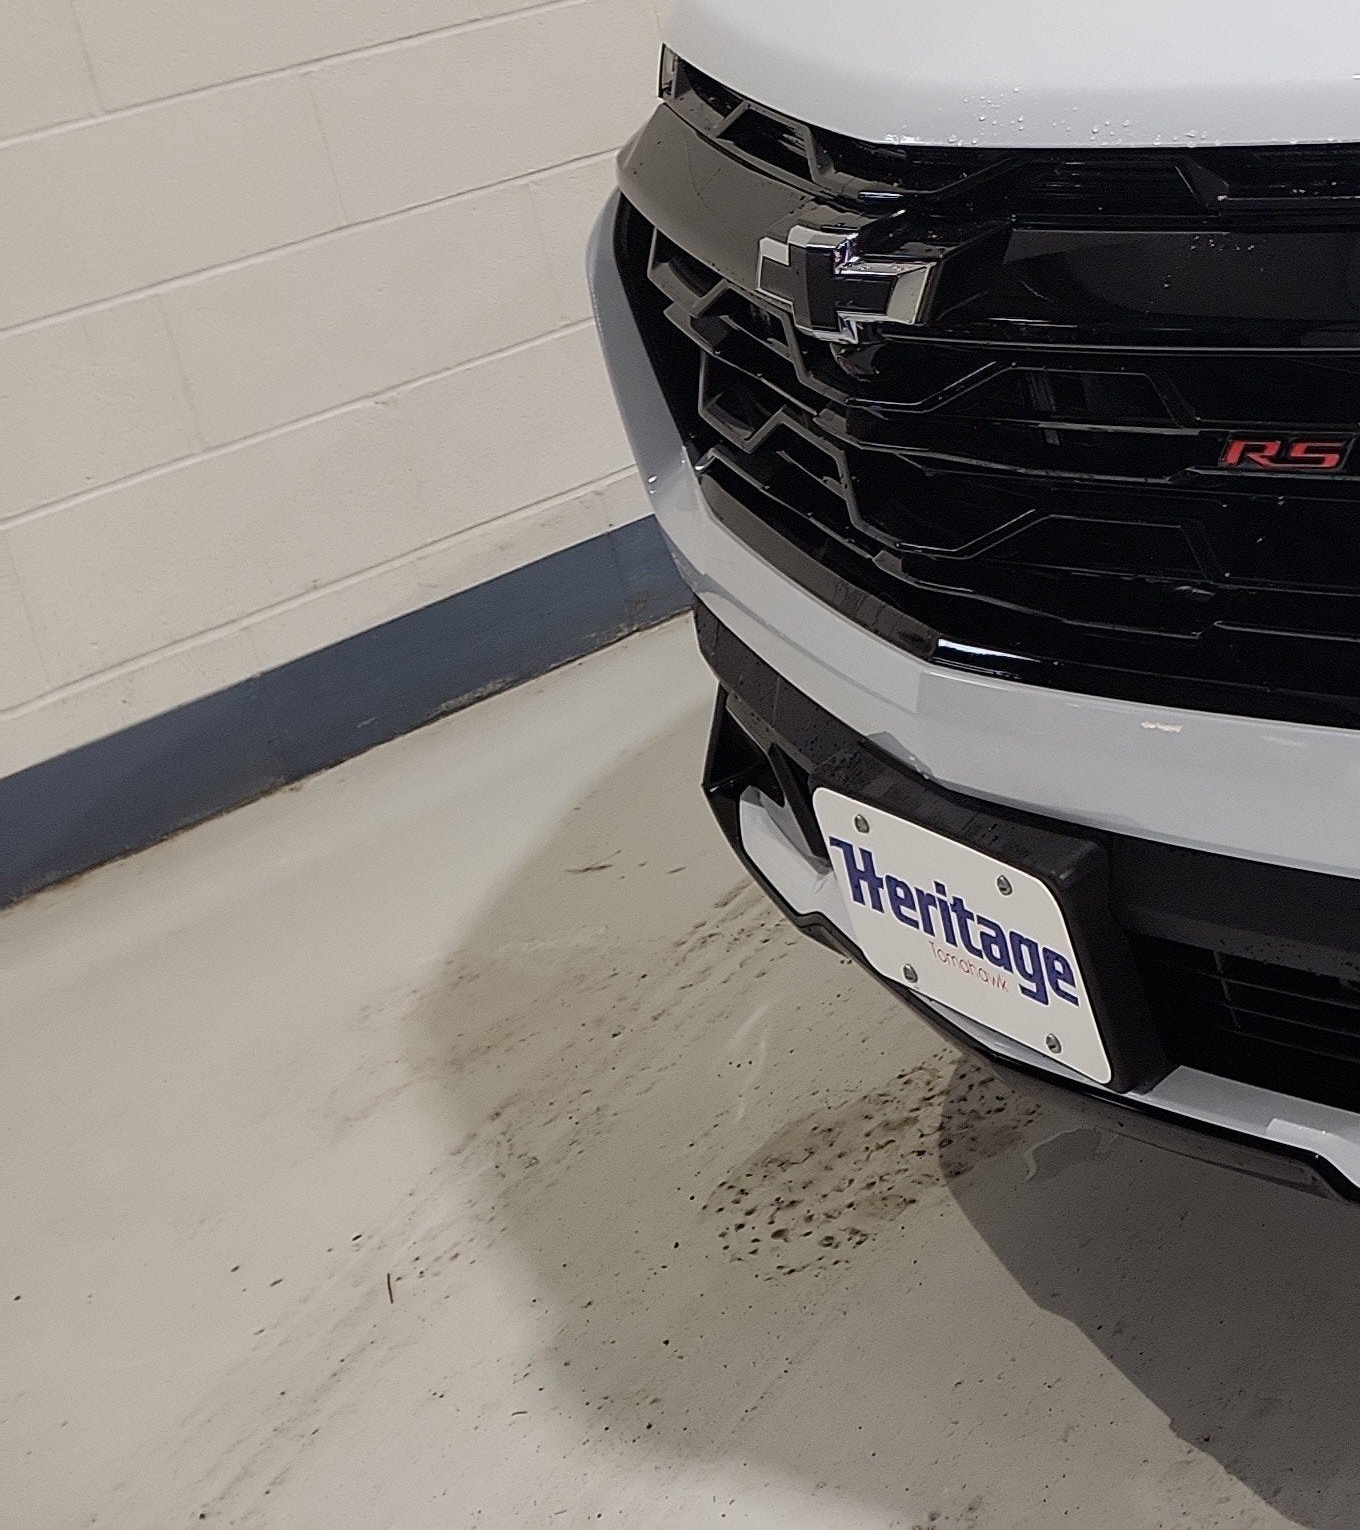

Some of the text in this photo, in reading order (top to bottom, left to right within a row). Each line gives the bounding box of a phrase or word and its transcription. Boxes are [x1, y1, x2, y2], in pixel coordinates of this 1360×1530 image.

[1222, 438, 1347, 468] RS
[828, 835, 1080, 1007] Heritage
[928, 940, 1009, 994] Tomahawk
